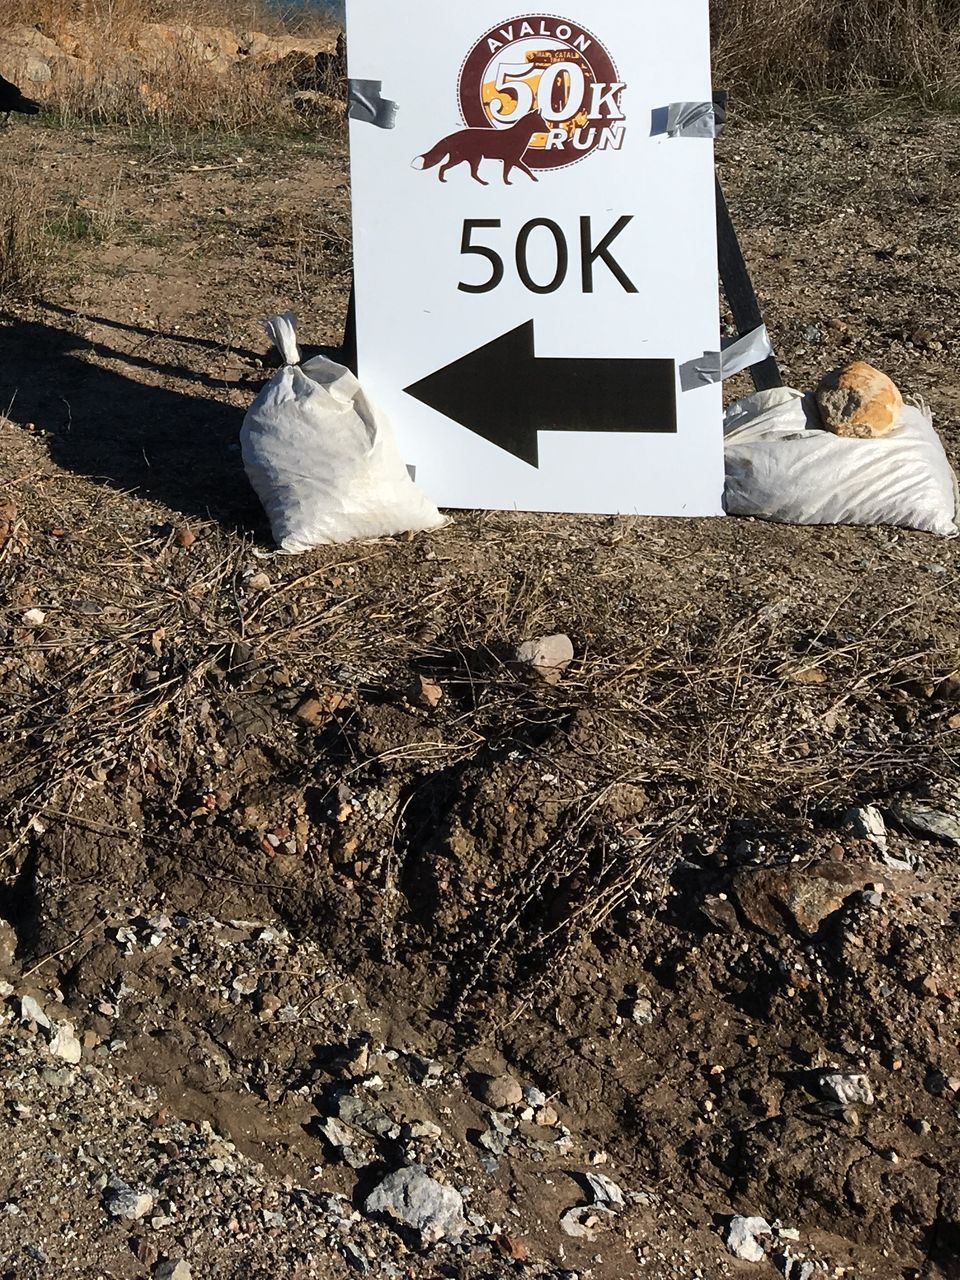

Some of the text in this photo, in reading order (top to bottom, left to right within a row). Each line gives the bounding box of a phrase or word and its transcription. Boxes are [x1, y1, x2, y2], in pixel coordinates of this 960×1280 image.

[487, 20, 592, 53] AVALON
[489, 61, 628, 125] 50K
[545, 126, 627, 151] RUN
[457, 214, 640, 295] 50K
